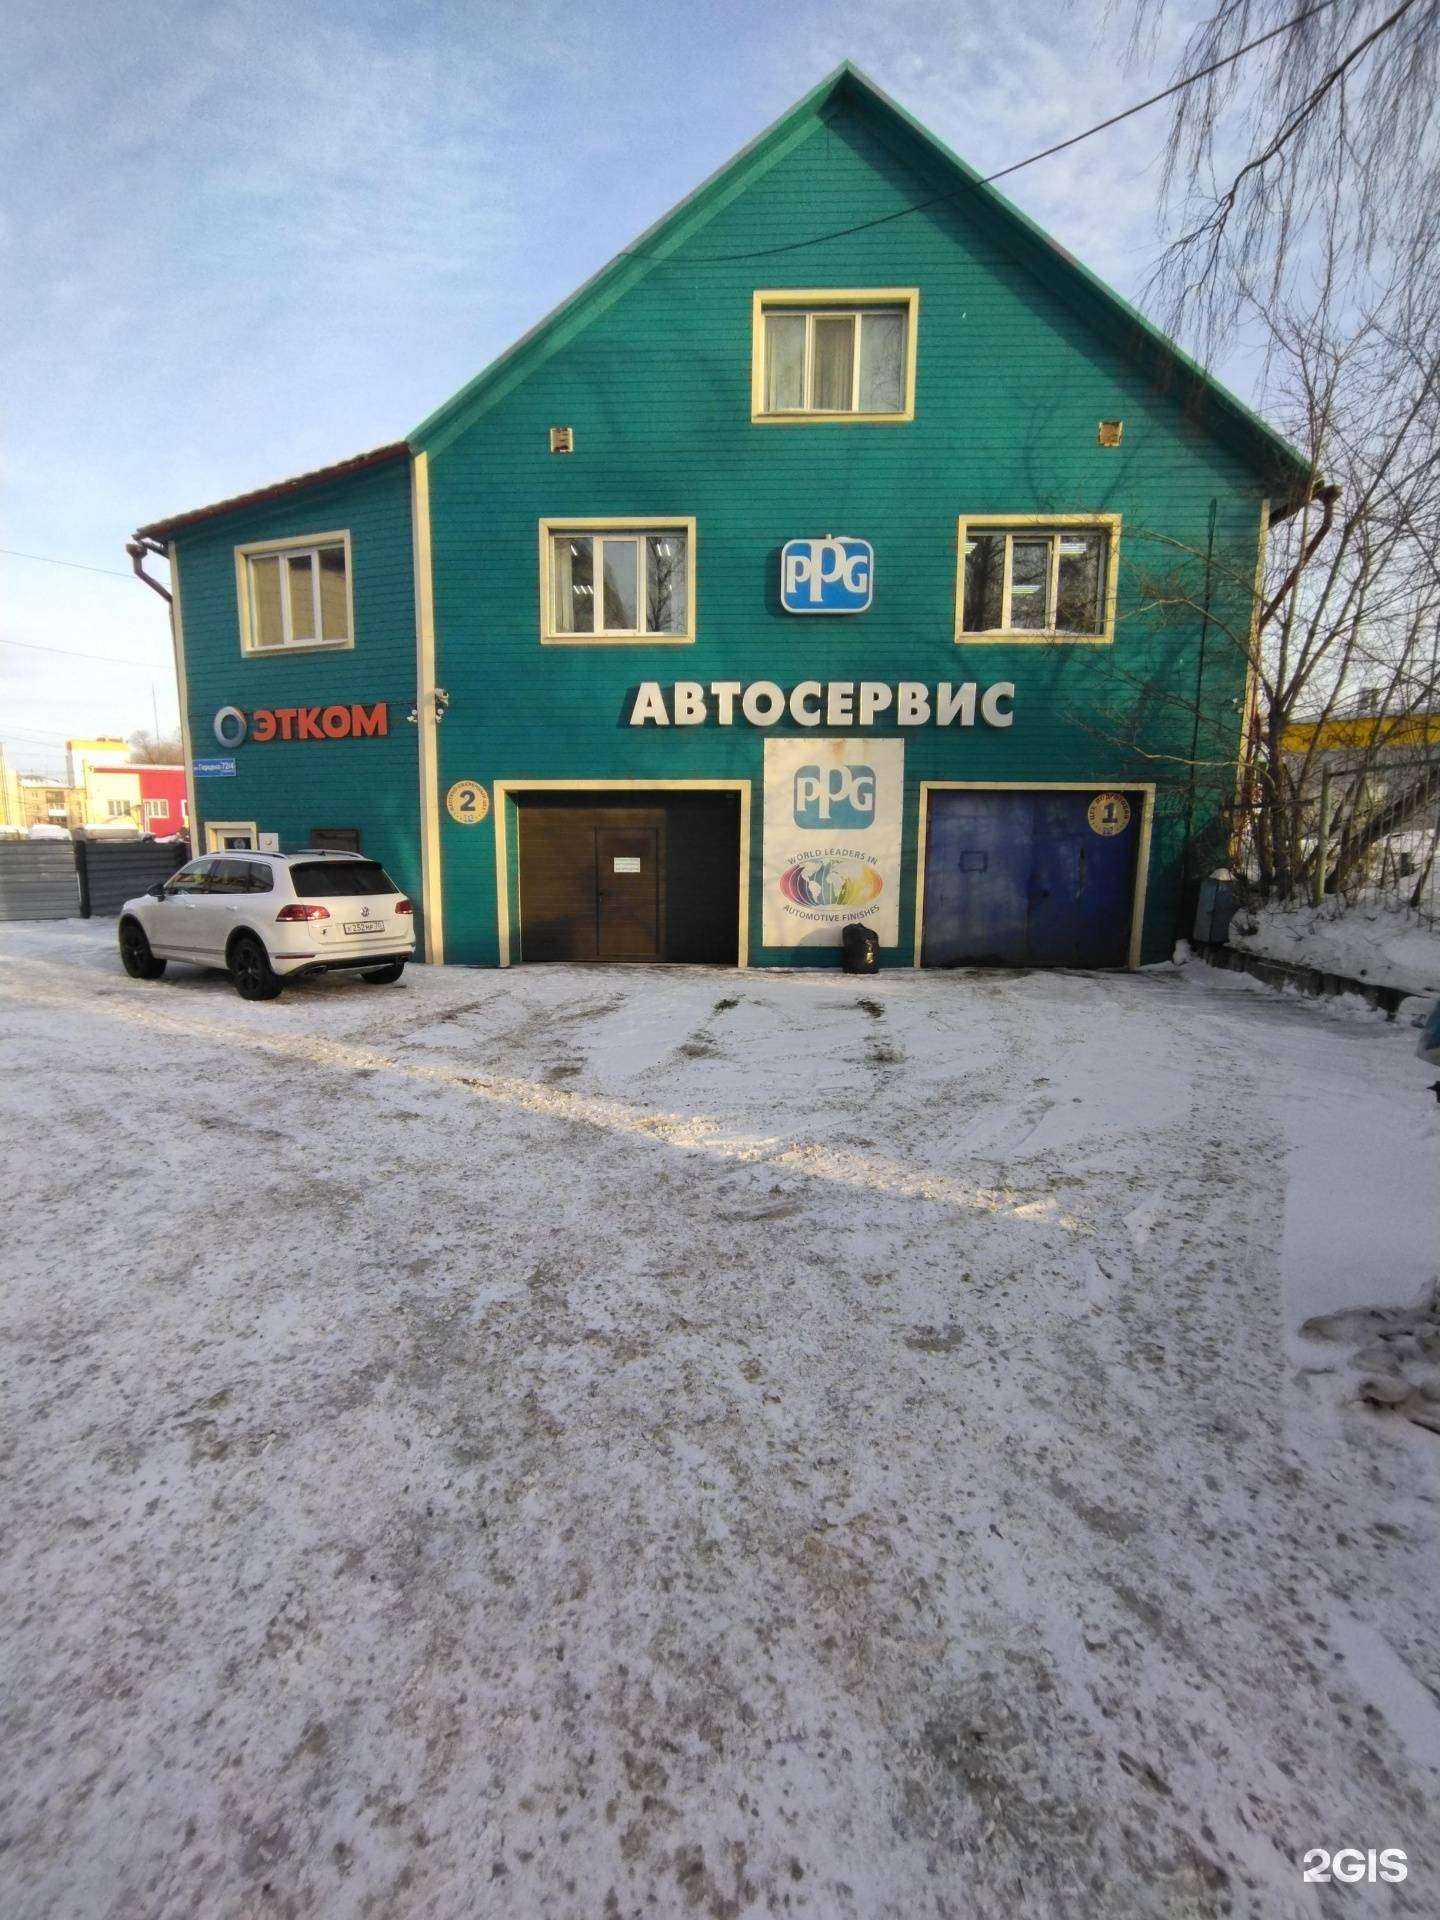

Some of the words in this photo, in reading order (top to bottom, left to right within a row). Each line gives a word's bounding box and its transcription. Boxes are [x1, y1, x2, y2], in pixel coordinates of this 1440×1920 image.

[785, 540, 868, 602] PPG
[629, 680, 1015, 727] АВТОСЕРВИС
[460, 790, 476, 811] 2
[796, 764, 873, 819] PPG
[1102, 802, 1118, 823] 1
[787, 849, 822, 864] WORLD
[824, 848, 865, 860] LEADERS
[867, 855, 878, 865] IN
[784, 904, 839, 921] AUTOMOTIVE
[842, 904, 880, 920] FINISHES
